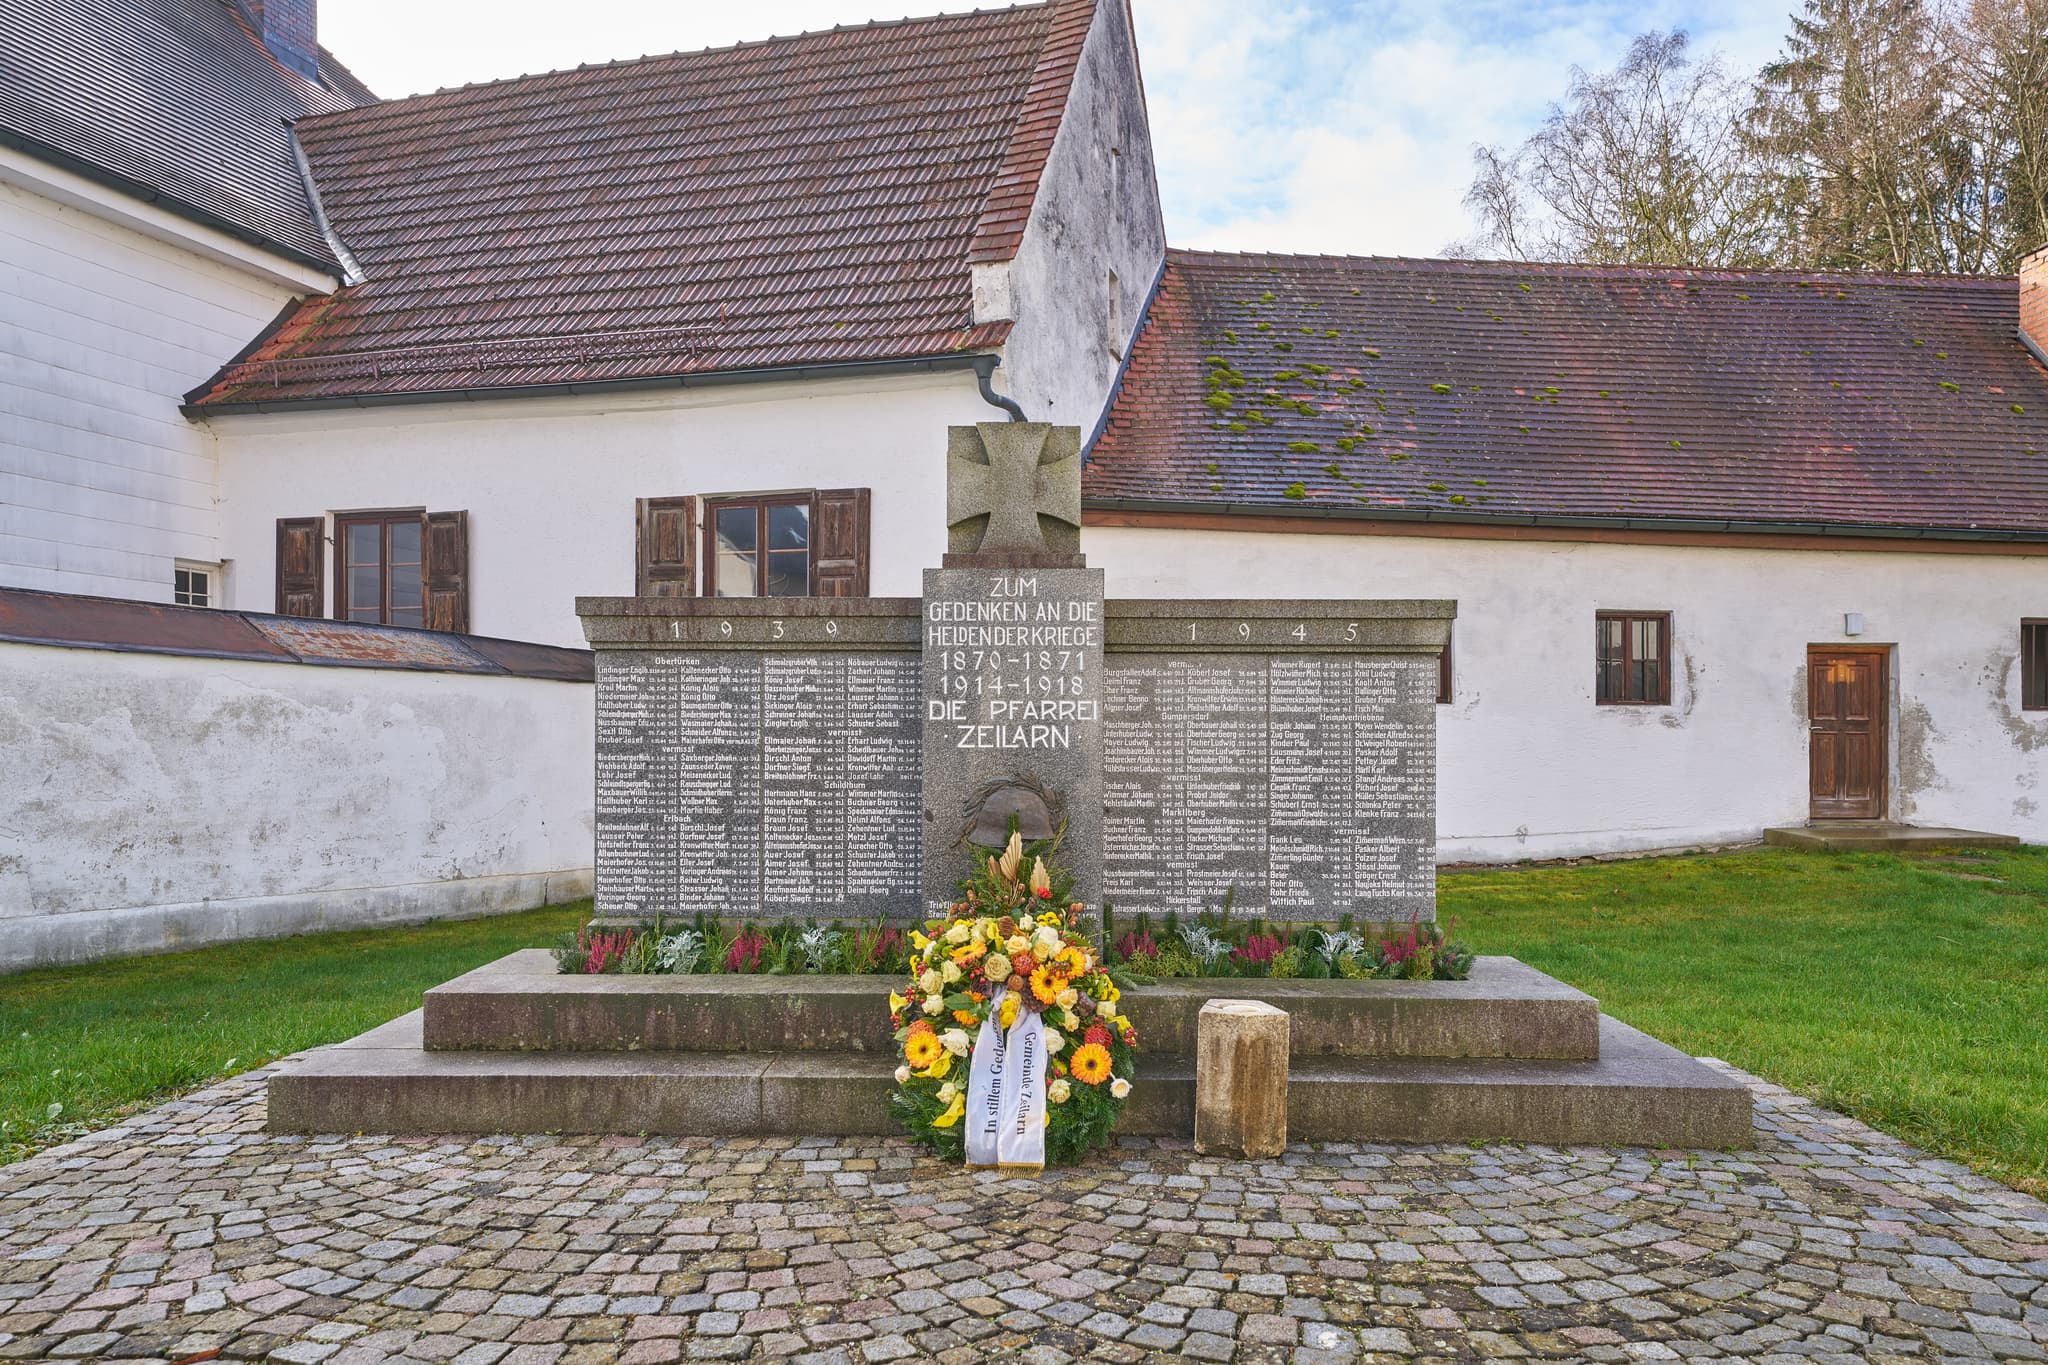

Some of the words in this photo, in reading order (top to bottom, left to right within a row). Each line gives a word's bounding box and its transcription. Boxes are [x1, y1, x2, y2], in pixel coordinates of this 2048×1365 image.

[989, 577, 1037, 597] ZUM
[929, 601, 1027, 622] GEDENKEN
[1035, 601, 1060, 622] AN
[1069, 601, 1097, 622] DIE
[655, 657, 700, 665] Obertürken
[929, 700, 967, 720] DIE
[990, 700, 1097, 720] PFARREI
[827, 728, 862, 737] vermisst
[957, 725, 1069, 748] ZEILARN
[661, 745, 694, 753] vermisst
[1021, 1032, 1037, 1089] Gemeinde
[986, 1079, 1000, 1116] stillem
[984, 1118, 997, 1134] In
